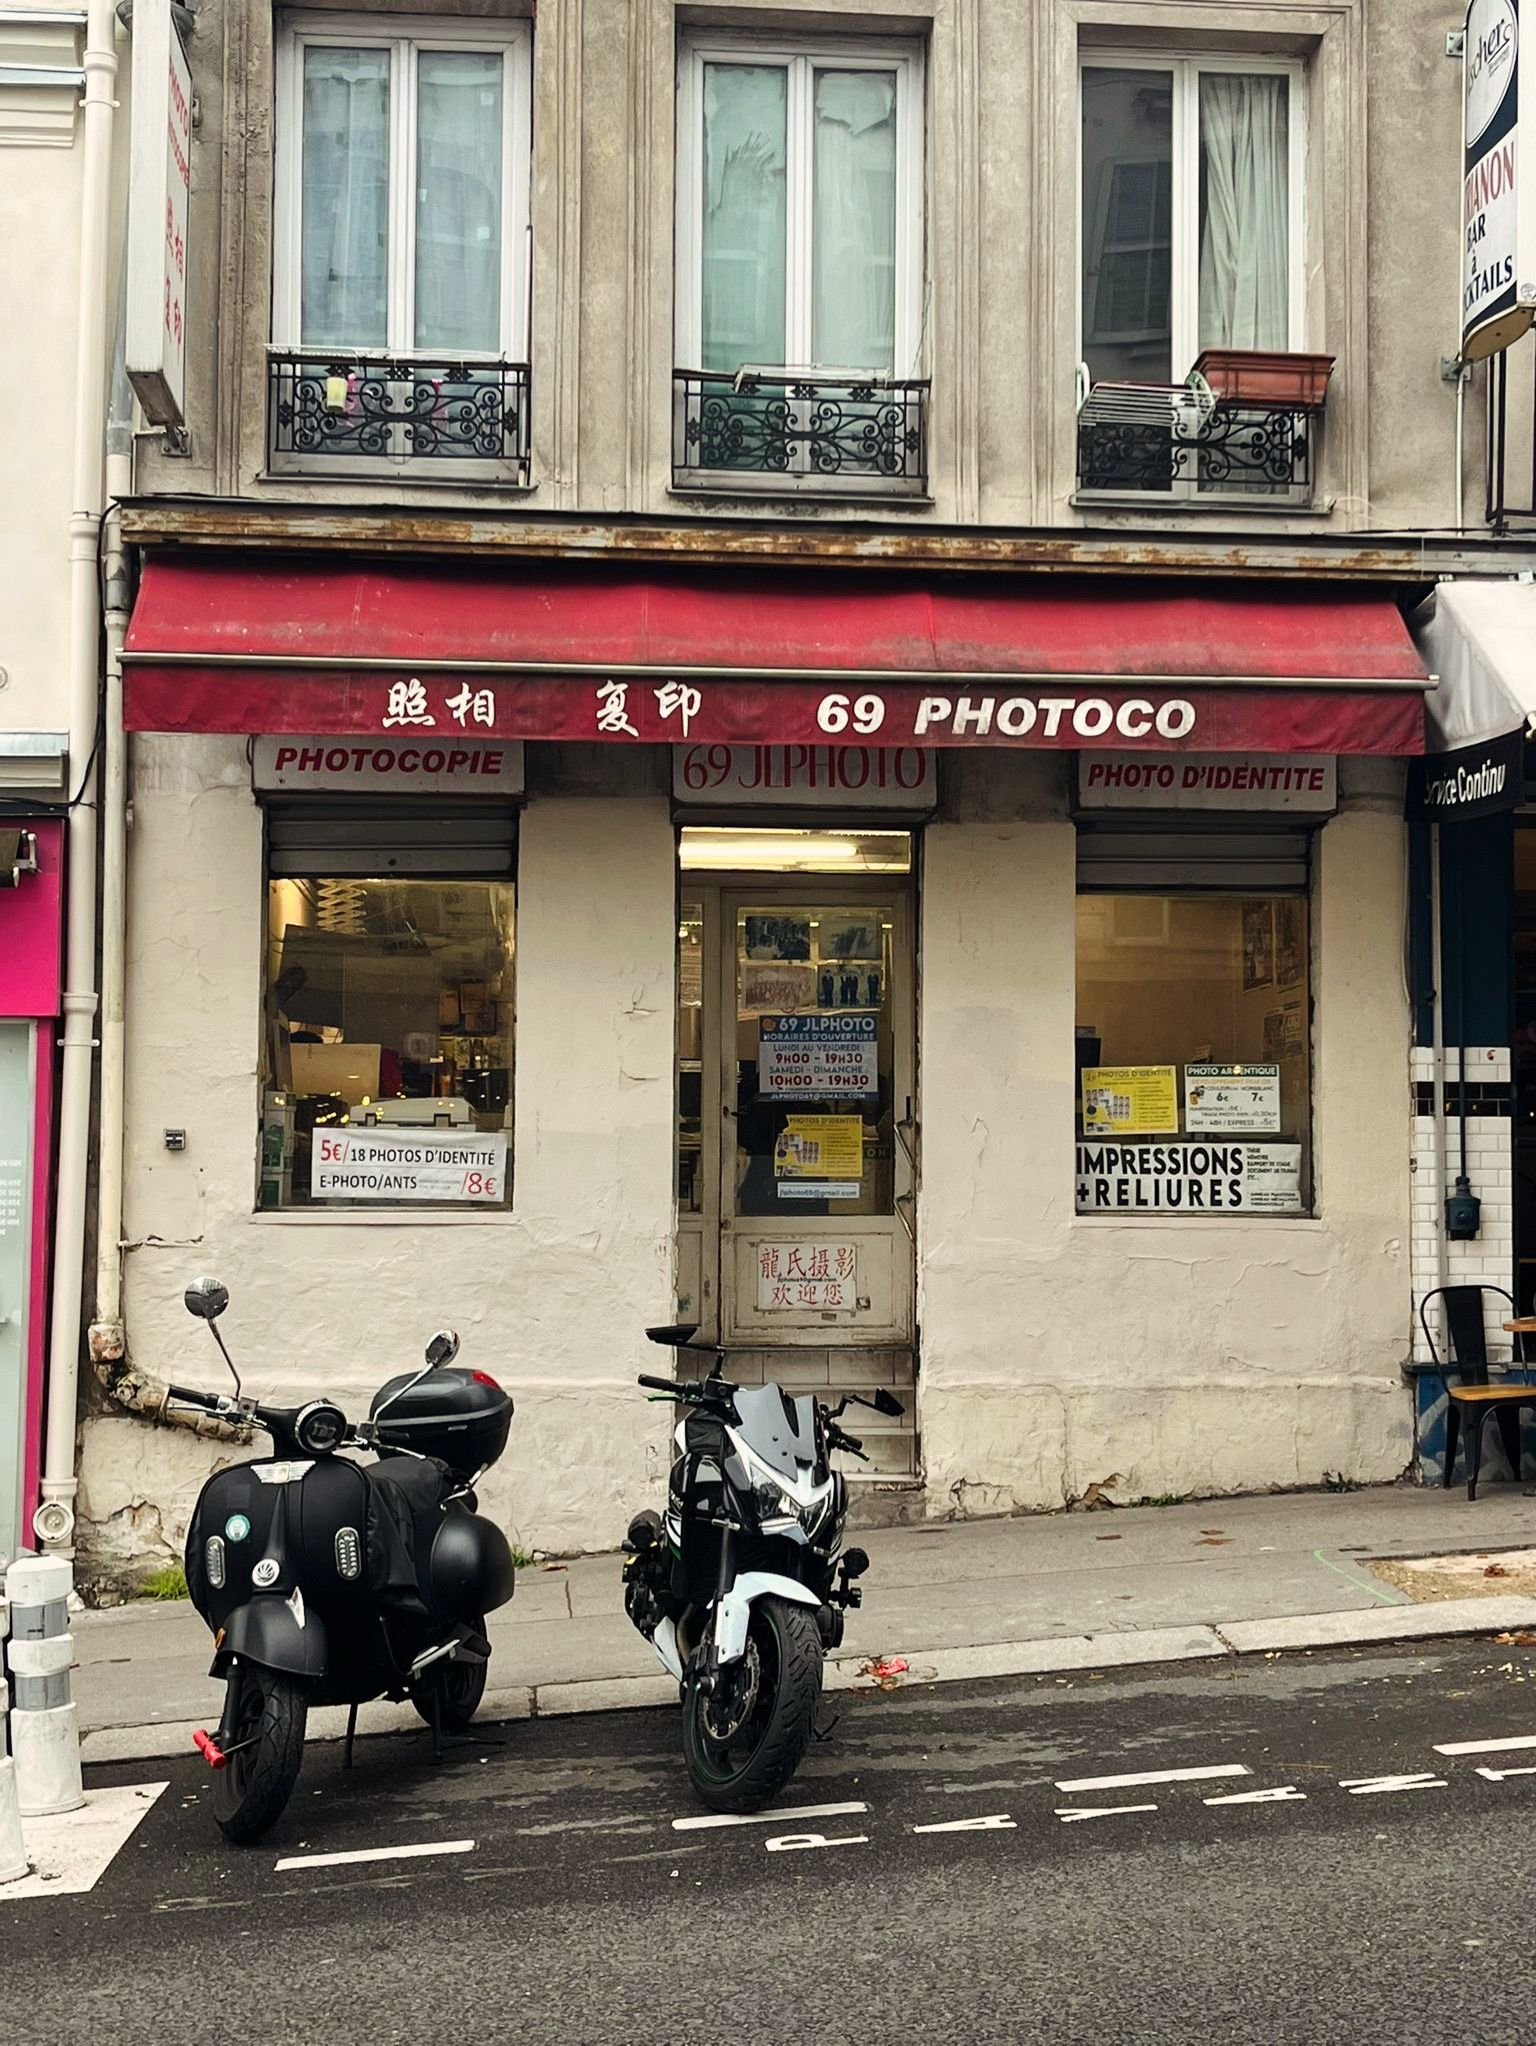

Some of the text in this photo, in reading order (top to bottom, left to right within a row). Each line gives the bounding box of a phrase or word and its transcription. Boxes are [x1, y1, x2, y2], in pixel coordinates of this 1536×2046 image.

[382, 680, 702, 738] 照相 复印
[816, 694, 1196, 738] 69 PHOTOCO
[275, 747, 503, 775] PHOTOCOPIE
[683, 745, 732, 789] 69
[1088, 763, 1174, 788] PHOTO
[1457, 759, 1506, 803] Continu
[780, 1018, 875, 1031] 69 JLPHOTO
[773, 1044, 799, 1052] LUNDI
[802, 1044, 813, 1052] AU
[816, 1044, 860, 1052] VENDREDI
[1188, 1067, 1219, 1075] PHOTO
[1216, 1093, 1263, 1101] 6€ 7€
[351, 1149, 366, 1162] 18
[369, 1149, 421, 1163] PHOTOS
[425, 1149, 495, 1166] D'IDENTITÉ
[1076, 1147, 1243, 1176] IMPRESSIONS
[320, 1174, 417, 1192] E-PHOTO/ANTS
[771, 1283, 844, 1306] 欢迎您
